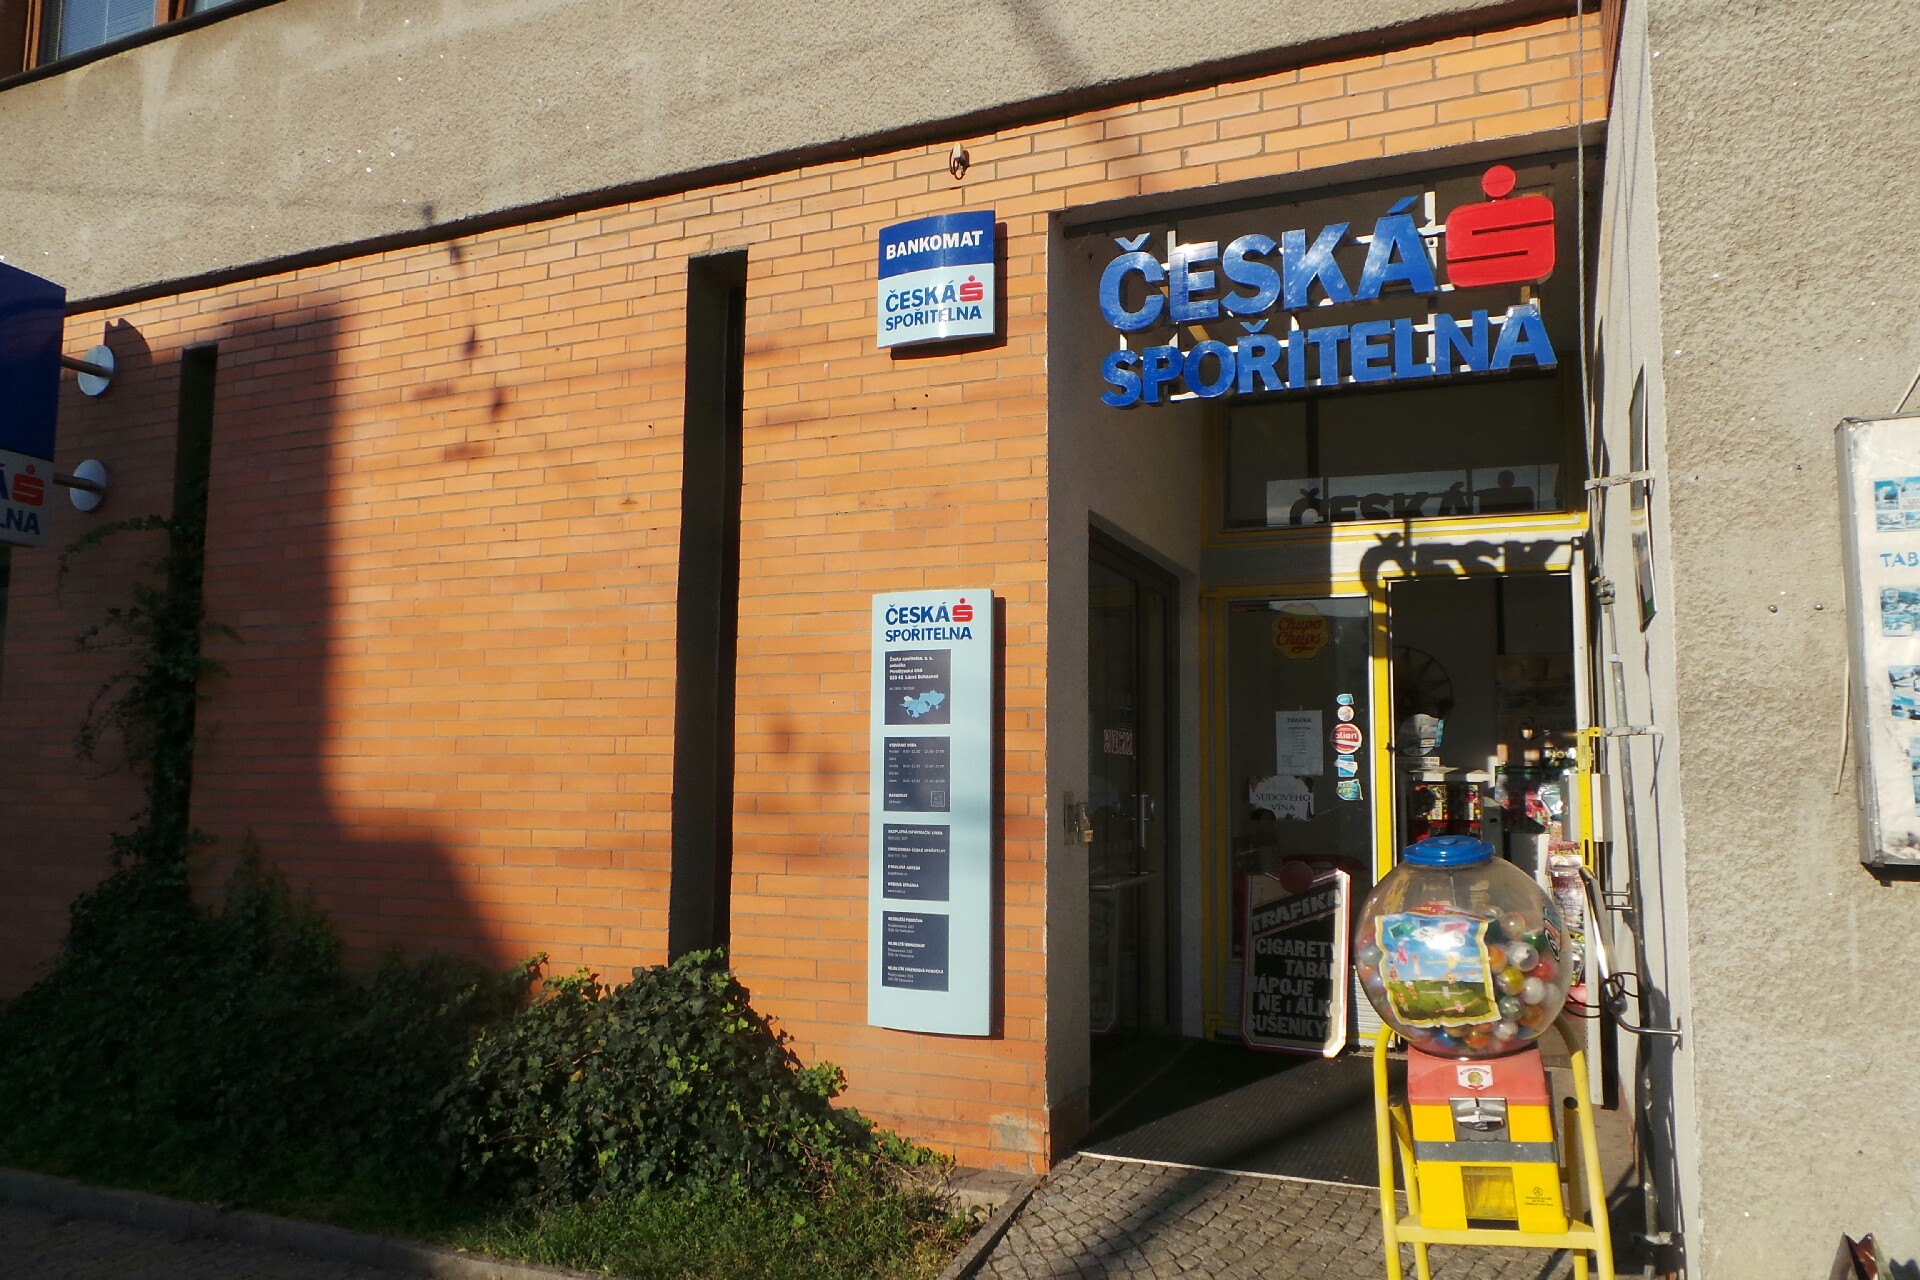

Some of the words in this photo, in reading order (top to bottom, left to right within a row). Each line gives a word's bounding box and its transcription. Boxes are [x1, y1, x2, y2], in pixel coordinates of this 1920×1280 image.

[886, 230, 984, 260] BANKOMAT
[1099, 195, 1437, 333] ČESKÁ
[885, 280, 957, 313] ČESKÁ
[885, 305, 982, 331] SPOŘITELNA
[1100, 303, 1558, 408] SPOŘITELNA
[885, 601, 950, 626] ČESKÁ
[885, 626, 972, 643] SPOŘITELNA
[1258, 993, 1282, 1013] NE
